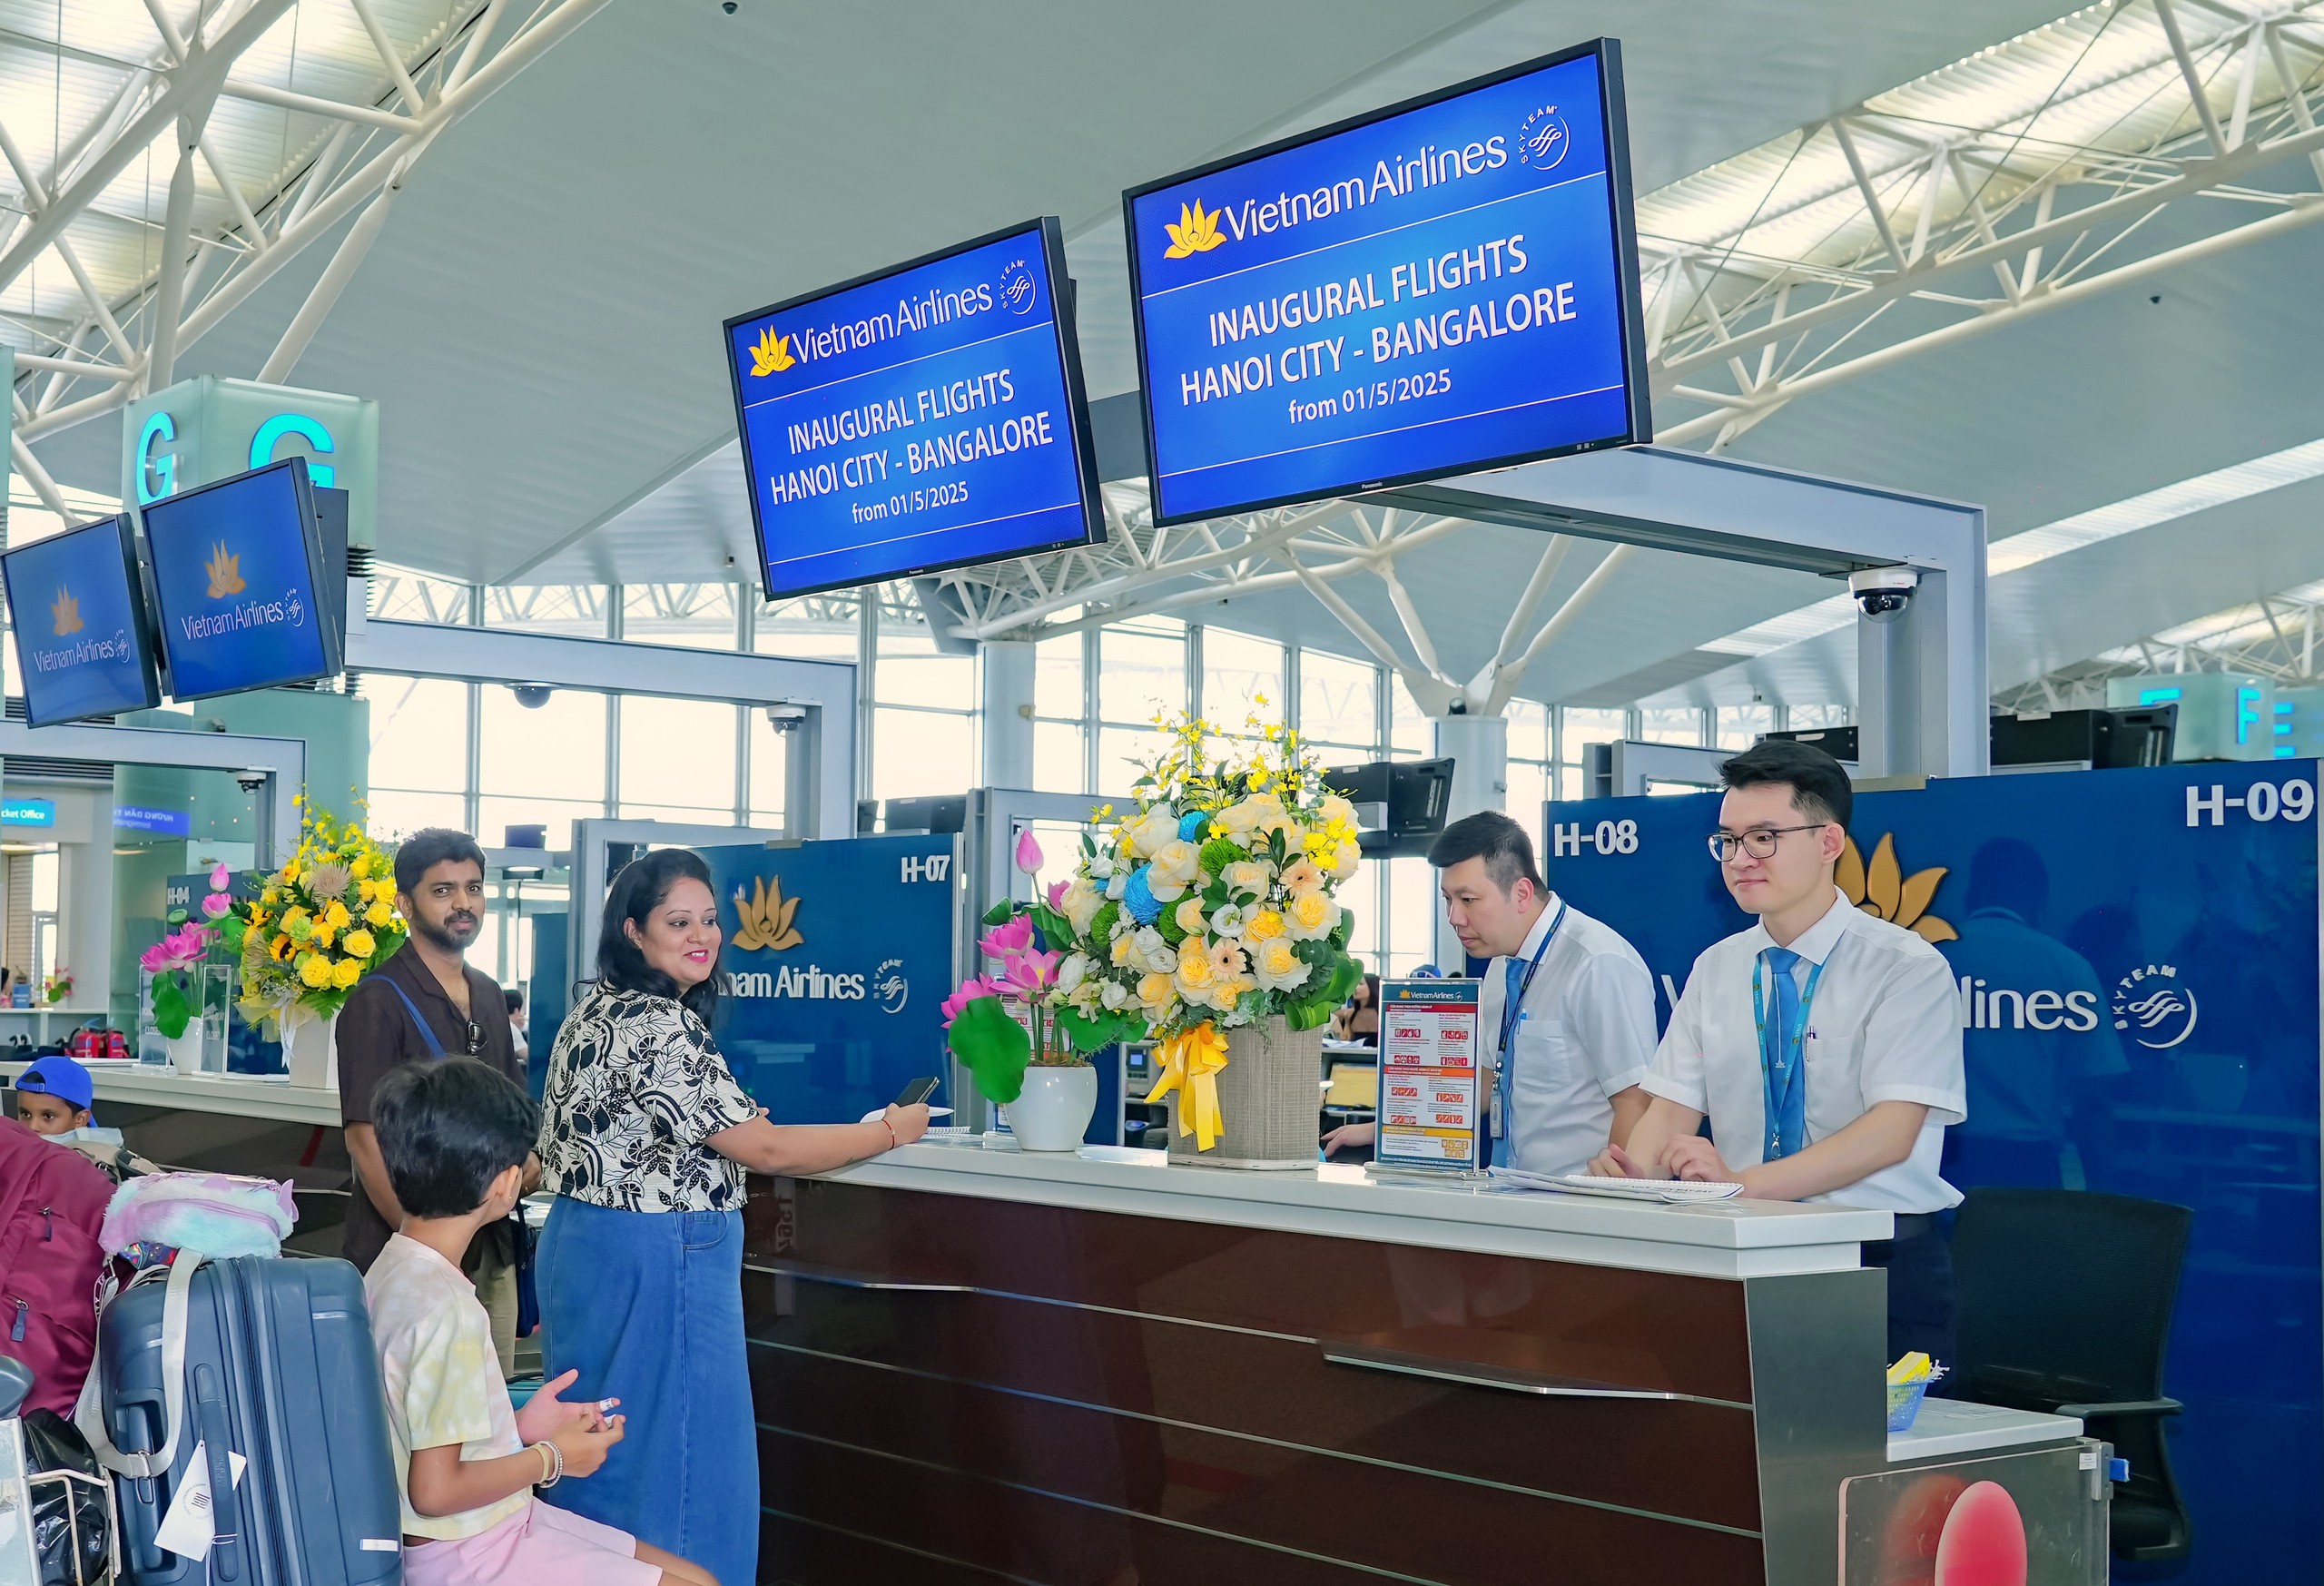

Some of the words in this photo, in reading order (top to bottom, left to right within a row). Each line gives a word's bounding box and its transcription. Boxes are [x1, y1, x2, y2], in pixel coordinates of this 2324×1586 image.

[1519, 105, 1556, 165] SKYTEAM
[1225, 177, 1365, 241] Vietnam
[1370, 135, 1508, 203] Airlines
[1000, 260, 1025, 310] SKYTEAM
[1208, 273, 1384, 348] INAUGURAL
[1391, 234, 1529, 303] FLIGHTS
[792, 313, 894, 364] Vietnam
[896, 282, 993, 337] Airlines
[1180, 357, 1273, 407] HANOI
[1279, 336, 1347, 384] CITY
[1372, 281, 1577, 365] BANGALORE
[787, 397, 915, 454] INAUGURAL
[917, 369, 1015, 423] FLIGHTS
[1288, 397, 1337, 424] from
[1341, 369, 1452, 411] 01/5/2025
[136, 411, 174, 506] G
[249, 413, 335, 488] G
[770, 462, 840, 505] HANOI
[842, 450, 889, 488] CITY
[907, 410, 1053, 475] BANGALORE
[852, 501, 888, 524] from
[890, 480, 969, 515] 01/5/2025
[182, 610, 234, 641] Vietnam
[234, 599, 284, 630] Airlines
[34, 648, 76, 674] Vietnam
[75, 637, 114, 665] Airlines
[2237, 687, 2261, 744] F
[22, 810, 45, 821] Office
[2186, 778, 2314, 827] H-09
[1554, 819, 1639, 857] H-08
[167, 886, 190, 905] H-04
[901, 854, 950, 883] H-07
[774, 964, 865, 1000] Airlines
[1410, 990, 1434, 999] Vietnam
[1433, 990, 1454, 1000] Airlines
[1961, 976, 2099, 1031] lines
[2112, 964, 2177, 1030] SKYTEAM
